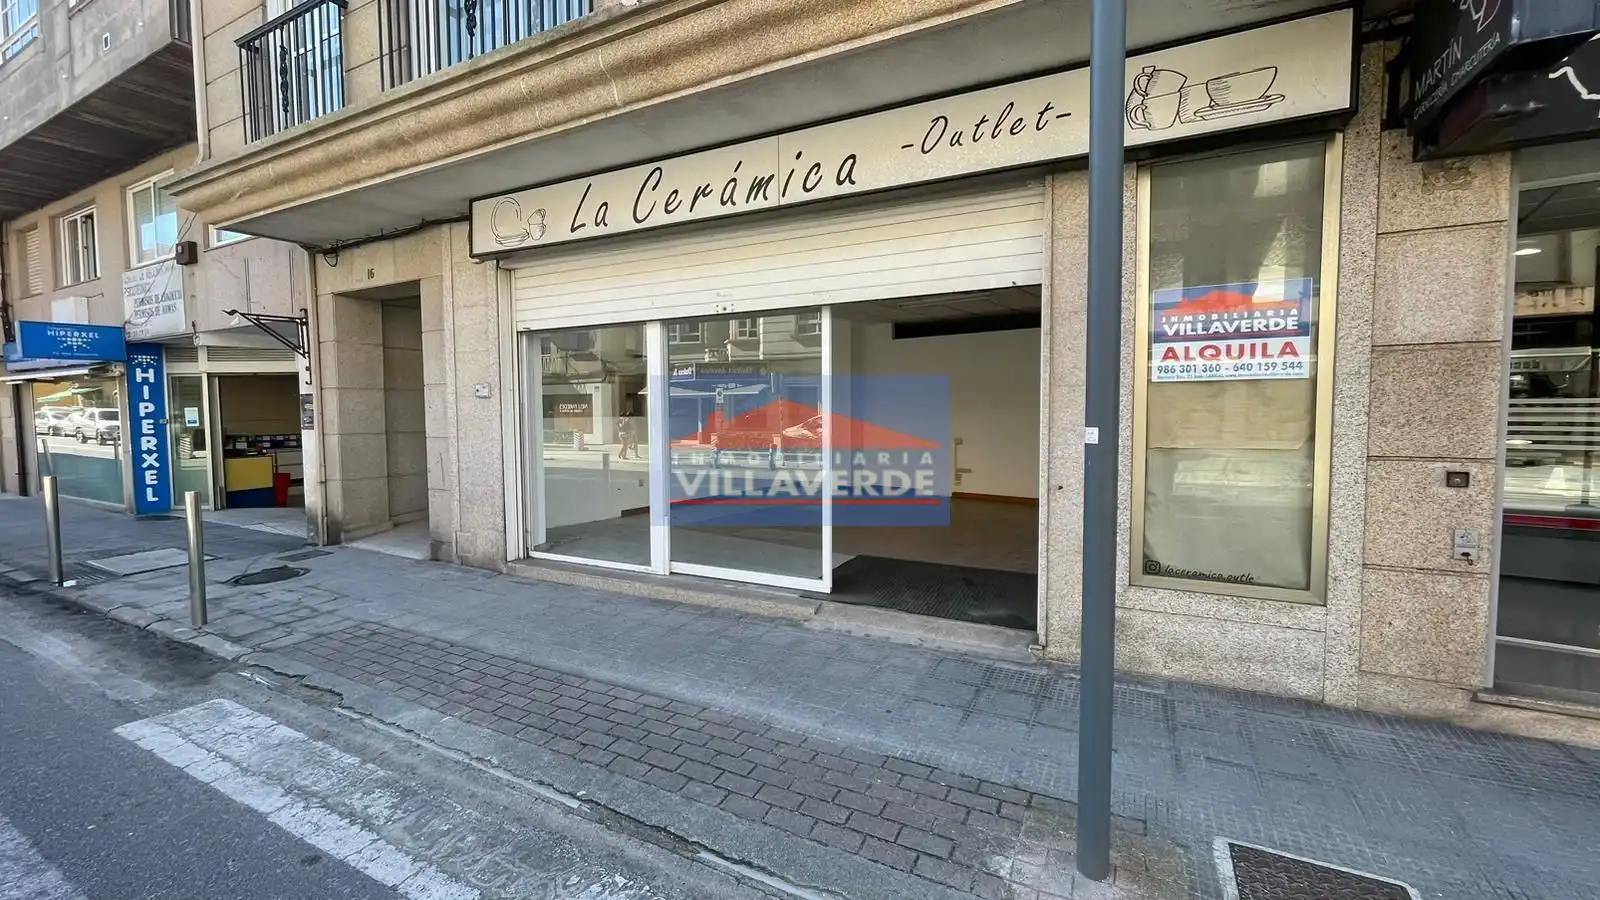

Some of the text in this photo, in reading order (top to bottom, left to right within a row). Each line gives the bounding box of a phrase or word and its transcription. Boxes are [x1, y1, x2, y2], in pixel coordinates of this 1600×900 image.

[1414, 36, 1463, 102] MARTÍN
[569, 182, 610, 235] La
[631, 150, 858, 224] Cerámica
[367, 268, 375, 280] 16
[1160, 308, 1299, 323] INMOBILIARIA
[47, 330, 100, 339] HIPERXEL
[1162, 316, 1299, 337] VILLAVERDE
[1160, 341, 1300, 363] ALQUILA
[1157, 364, 1176, 374] 986
[1179, 364, 1197, 374] 301
[1201, 363, 1221, 373] 360
[1233, 363, 1253, 372] 640
[1257, 362, 1278, 371] 159
[1281, 361, 1303, 371] 544
[135, 367, 160, 502] HIPERXEL
